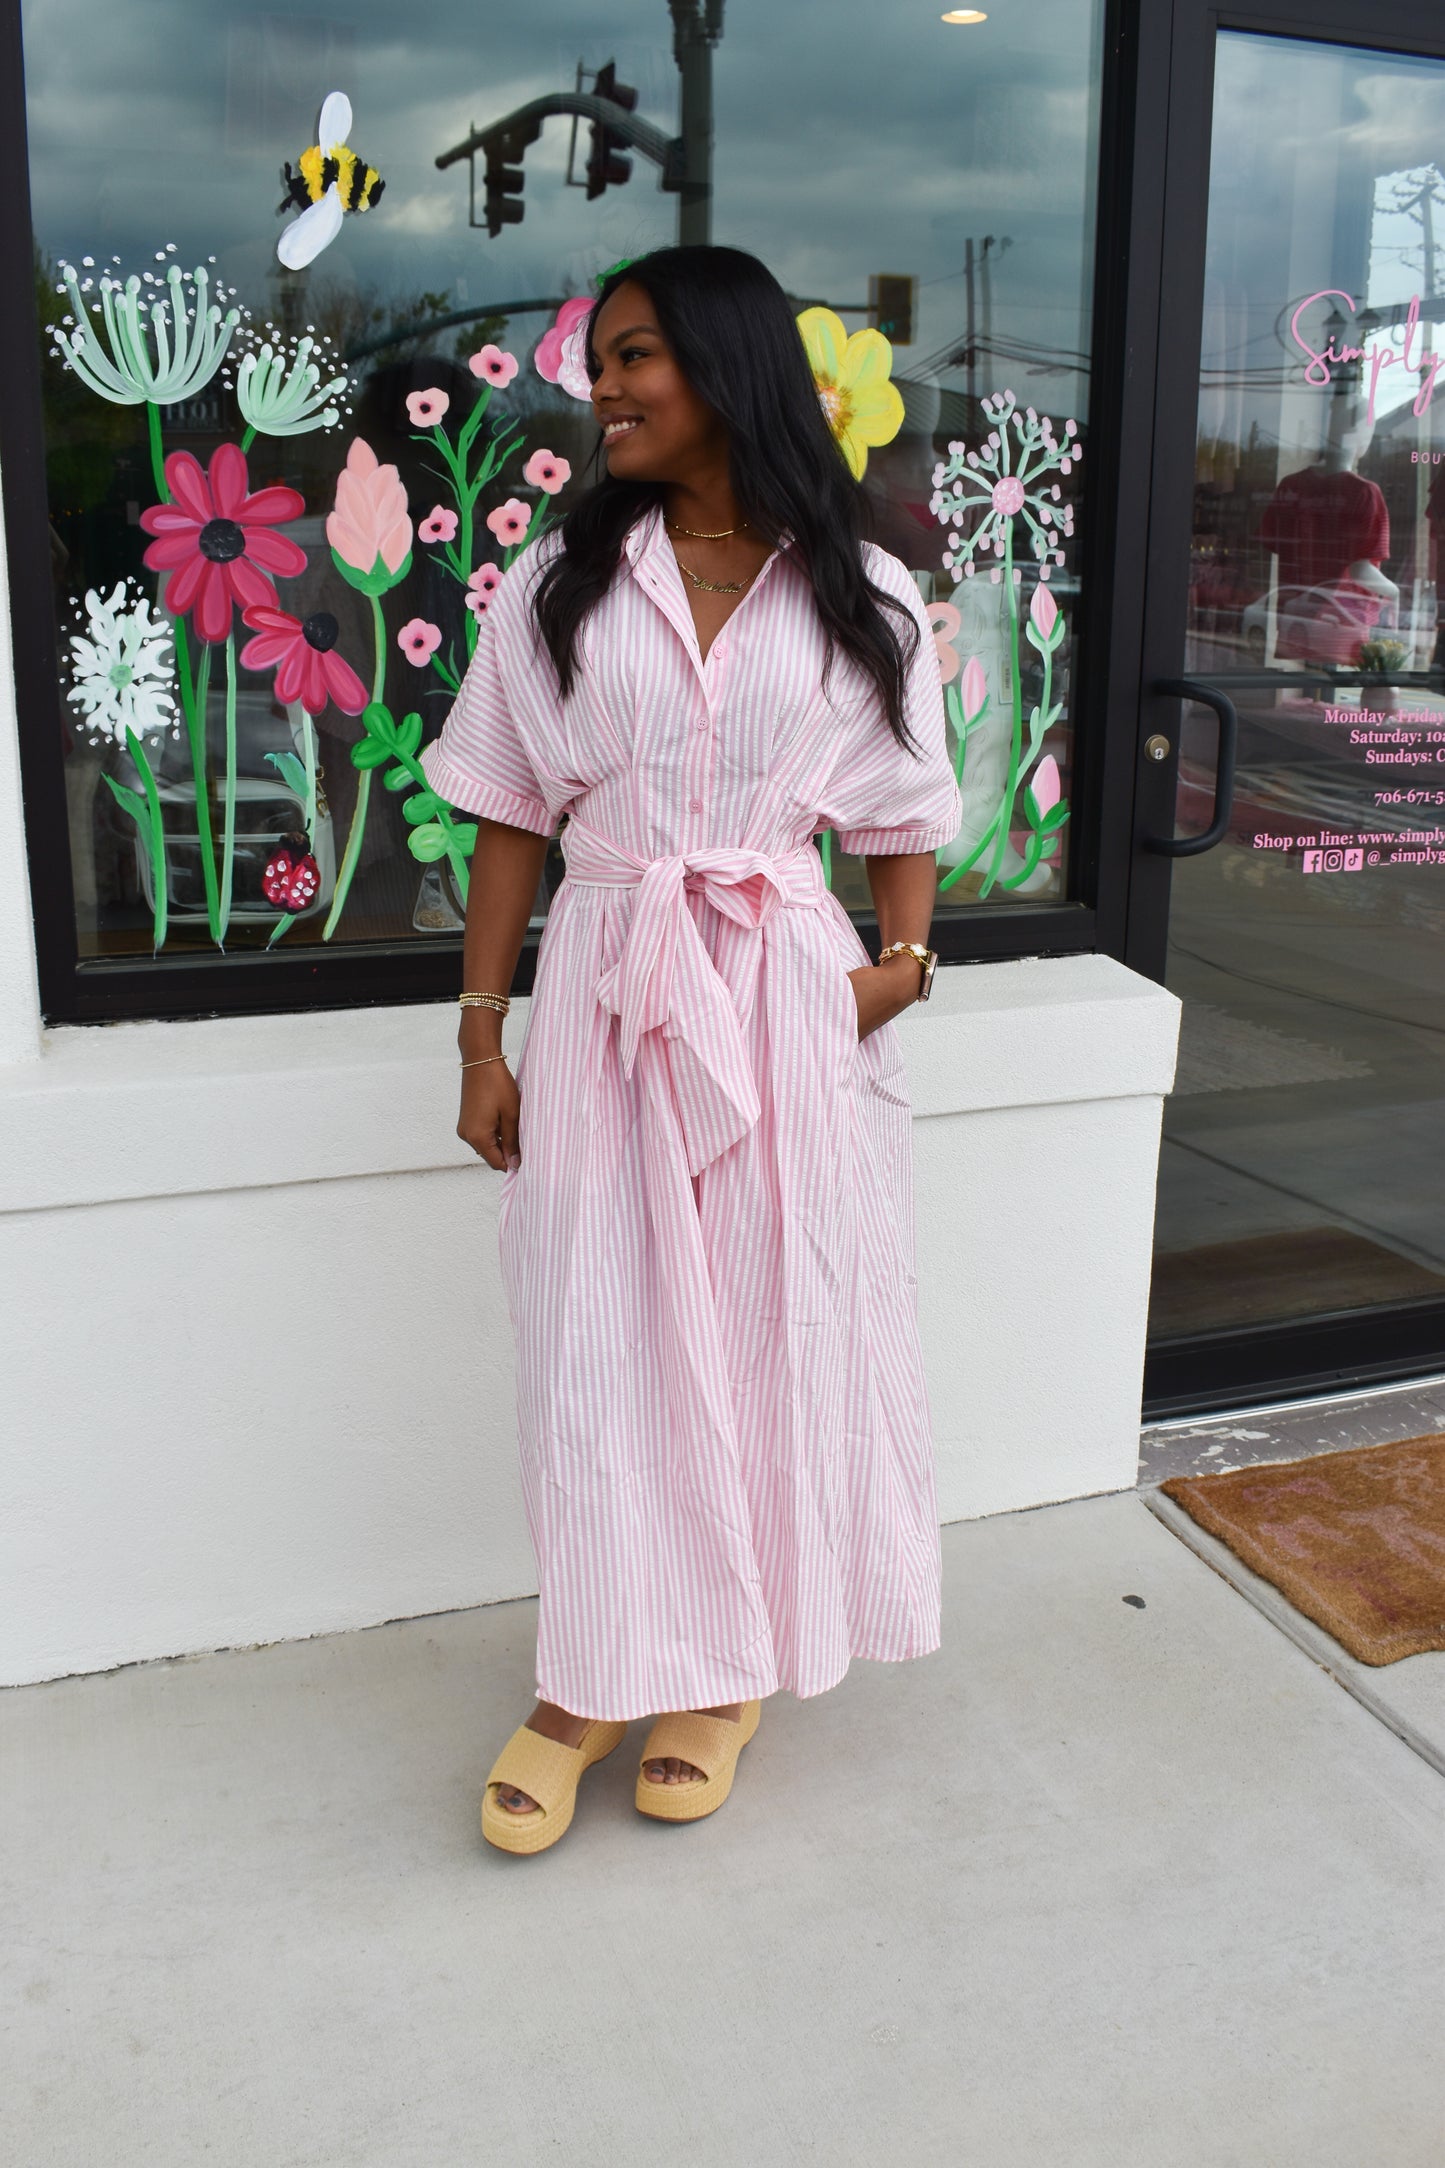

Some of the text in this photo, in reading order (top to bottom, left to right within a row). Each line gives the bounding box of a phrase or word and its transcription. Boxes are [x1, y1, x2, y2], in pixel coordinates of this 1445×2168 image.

[1291, 289, 1445, 426] Simply
[1410, 451, 1445, 465] BOU
[1324, 709, 1386, 726] Monday
[1398, 707, 1445, 726] Friday
[1350, 728, 1422, 746] Saturday:
[1365, 748, 1432, 766] Sundays:
[1374, 788, 1445, 807] 706-671-5
[1253, 827, 1445, 850] Shop on line: www.simply
